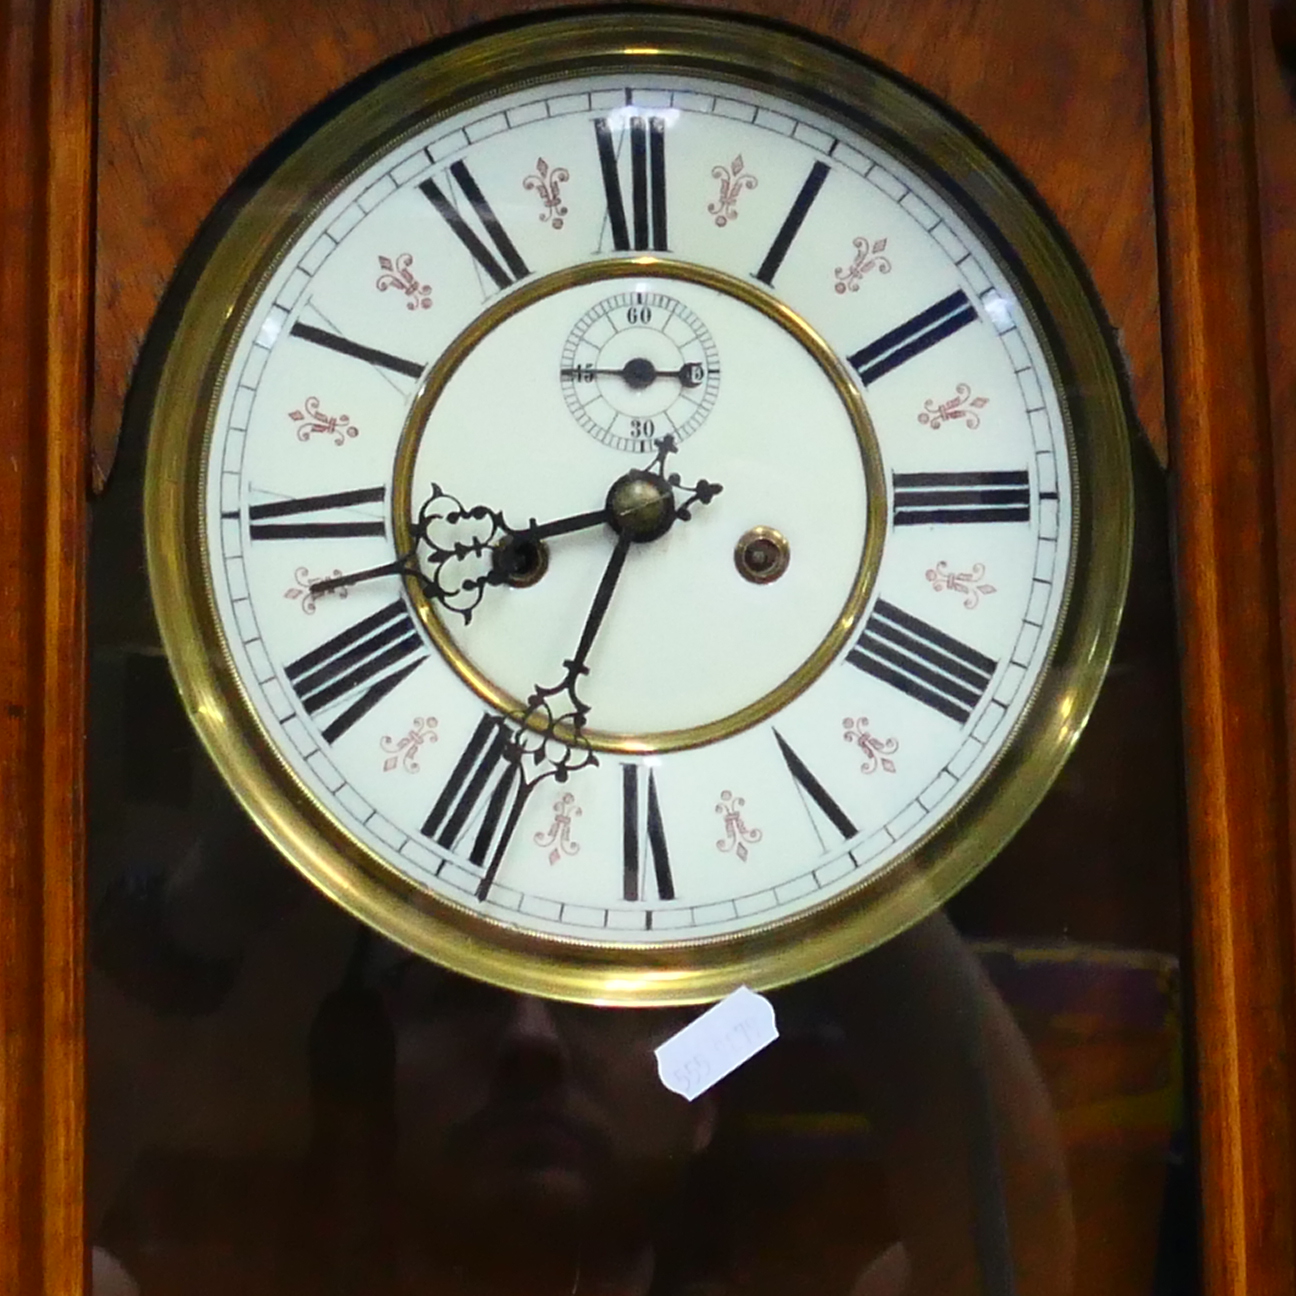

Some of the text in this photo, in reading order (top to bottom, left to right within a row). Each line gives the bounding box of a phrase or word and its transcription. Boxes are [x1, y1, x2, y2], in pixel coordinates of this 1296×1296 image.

[415, 157, 536, 303] XI
[593, 115, 674, 255] XII
[749, 157, 834, 290] I
[289, 298, 428, 399] X
[626, 306, 652, 325] 60
[845, 285, 984, 386] II
[629, 419, 655, 438] 30
[249, 483, 387, 541] IX
[893, 470, 1033, 526] III
[283, 599, 430, 745] VIII
[845, 598, 1001, 725] IIII
[621, 762, 676, 902] VI
[772, 726, 860, 856] V
